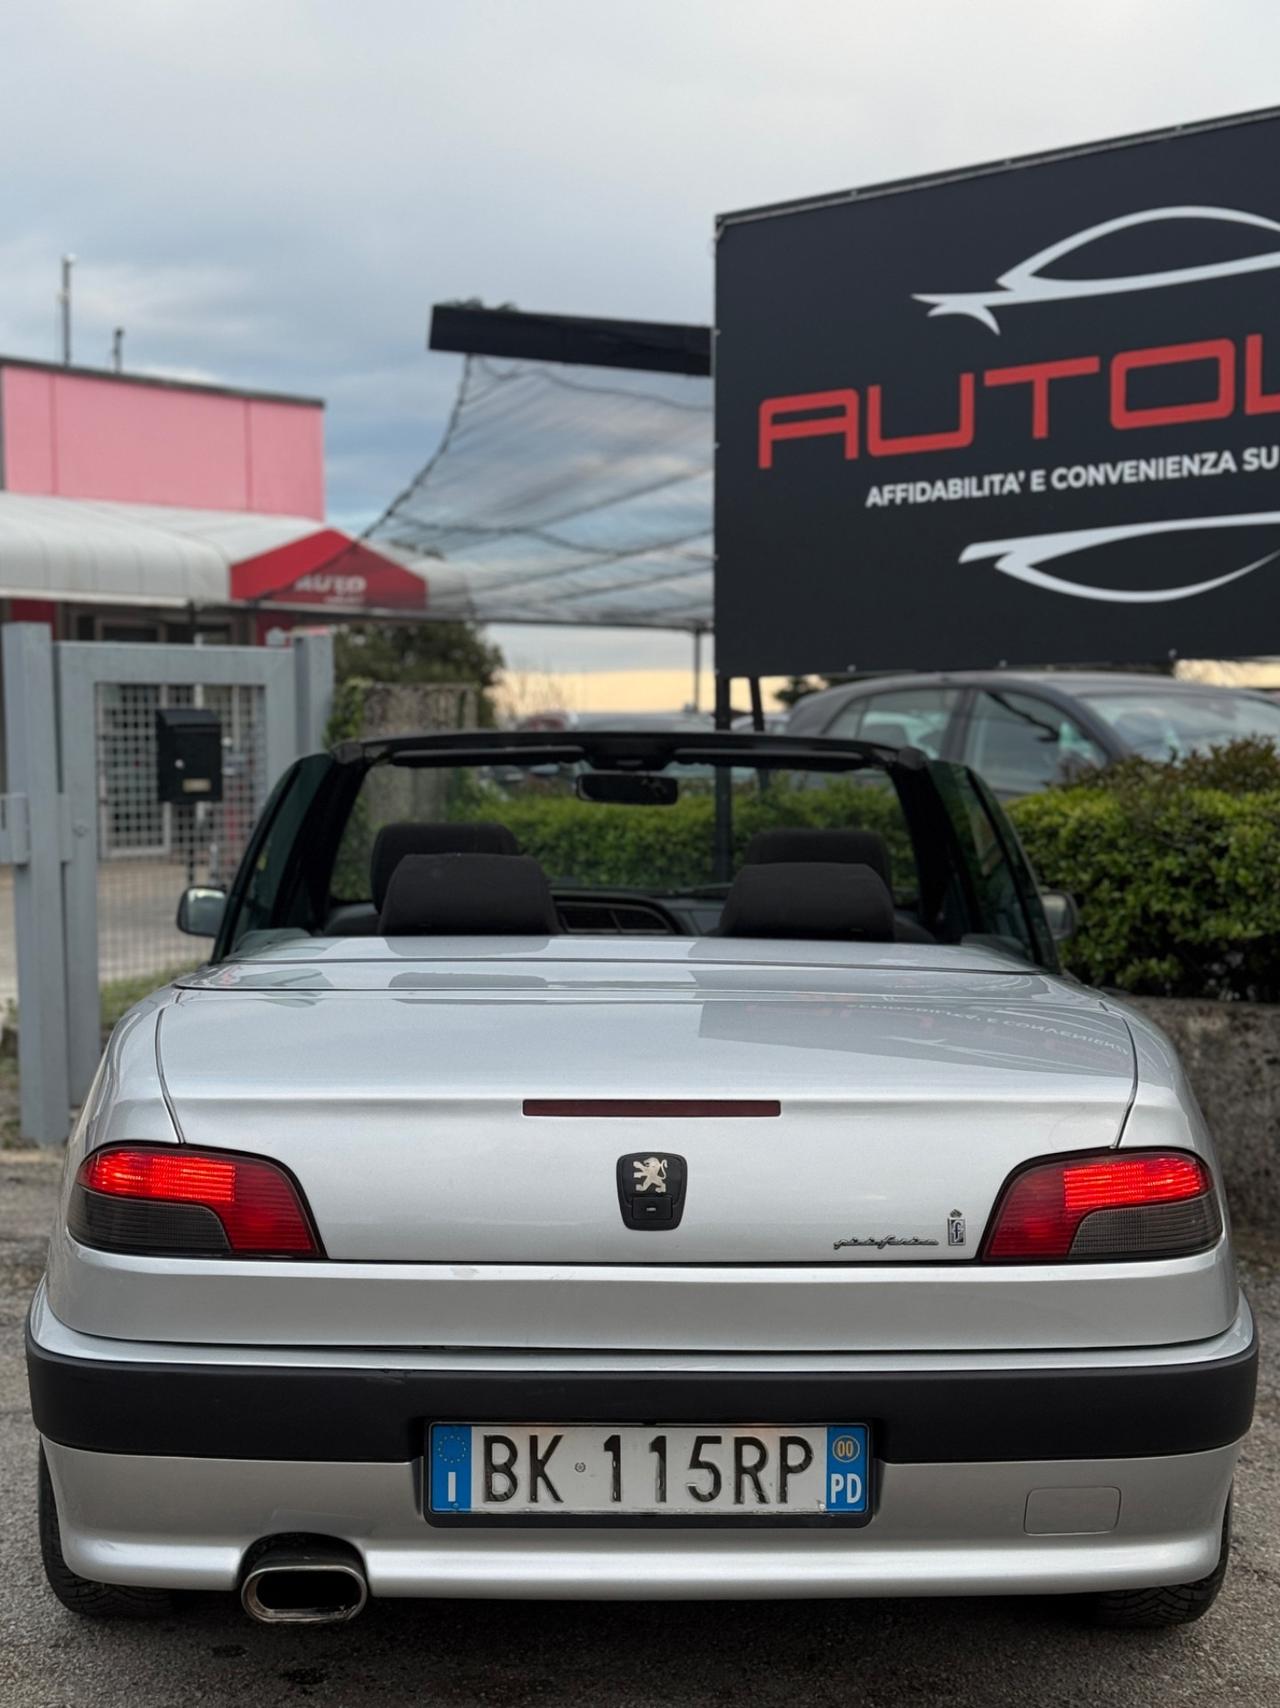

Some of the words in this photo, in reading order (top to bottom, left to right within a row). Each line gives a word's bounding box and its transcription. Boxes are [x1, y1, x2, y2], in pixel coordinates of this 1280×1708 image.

[759, 334, 1280, 469] AUTOL
[866, 470, 1025, 507] AFFIDABILITA'
[1031, 470, 1046, 492] E
[1051, 450, 1237, 490] CONVENIENZA
[1242, 446, 1280, 471] SU
[483, 1434, 563, 1504] BK
[603, 1435, 814, 1504] 115RP
[830, 1473, 862, 1504] PD
